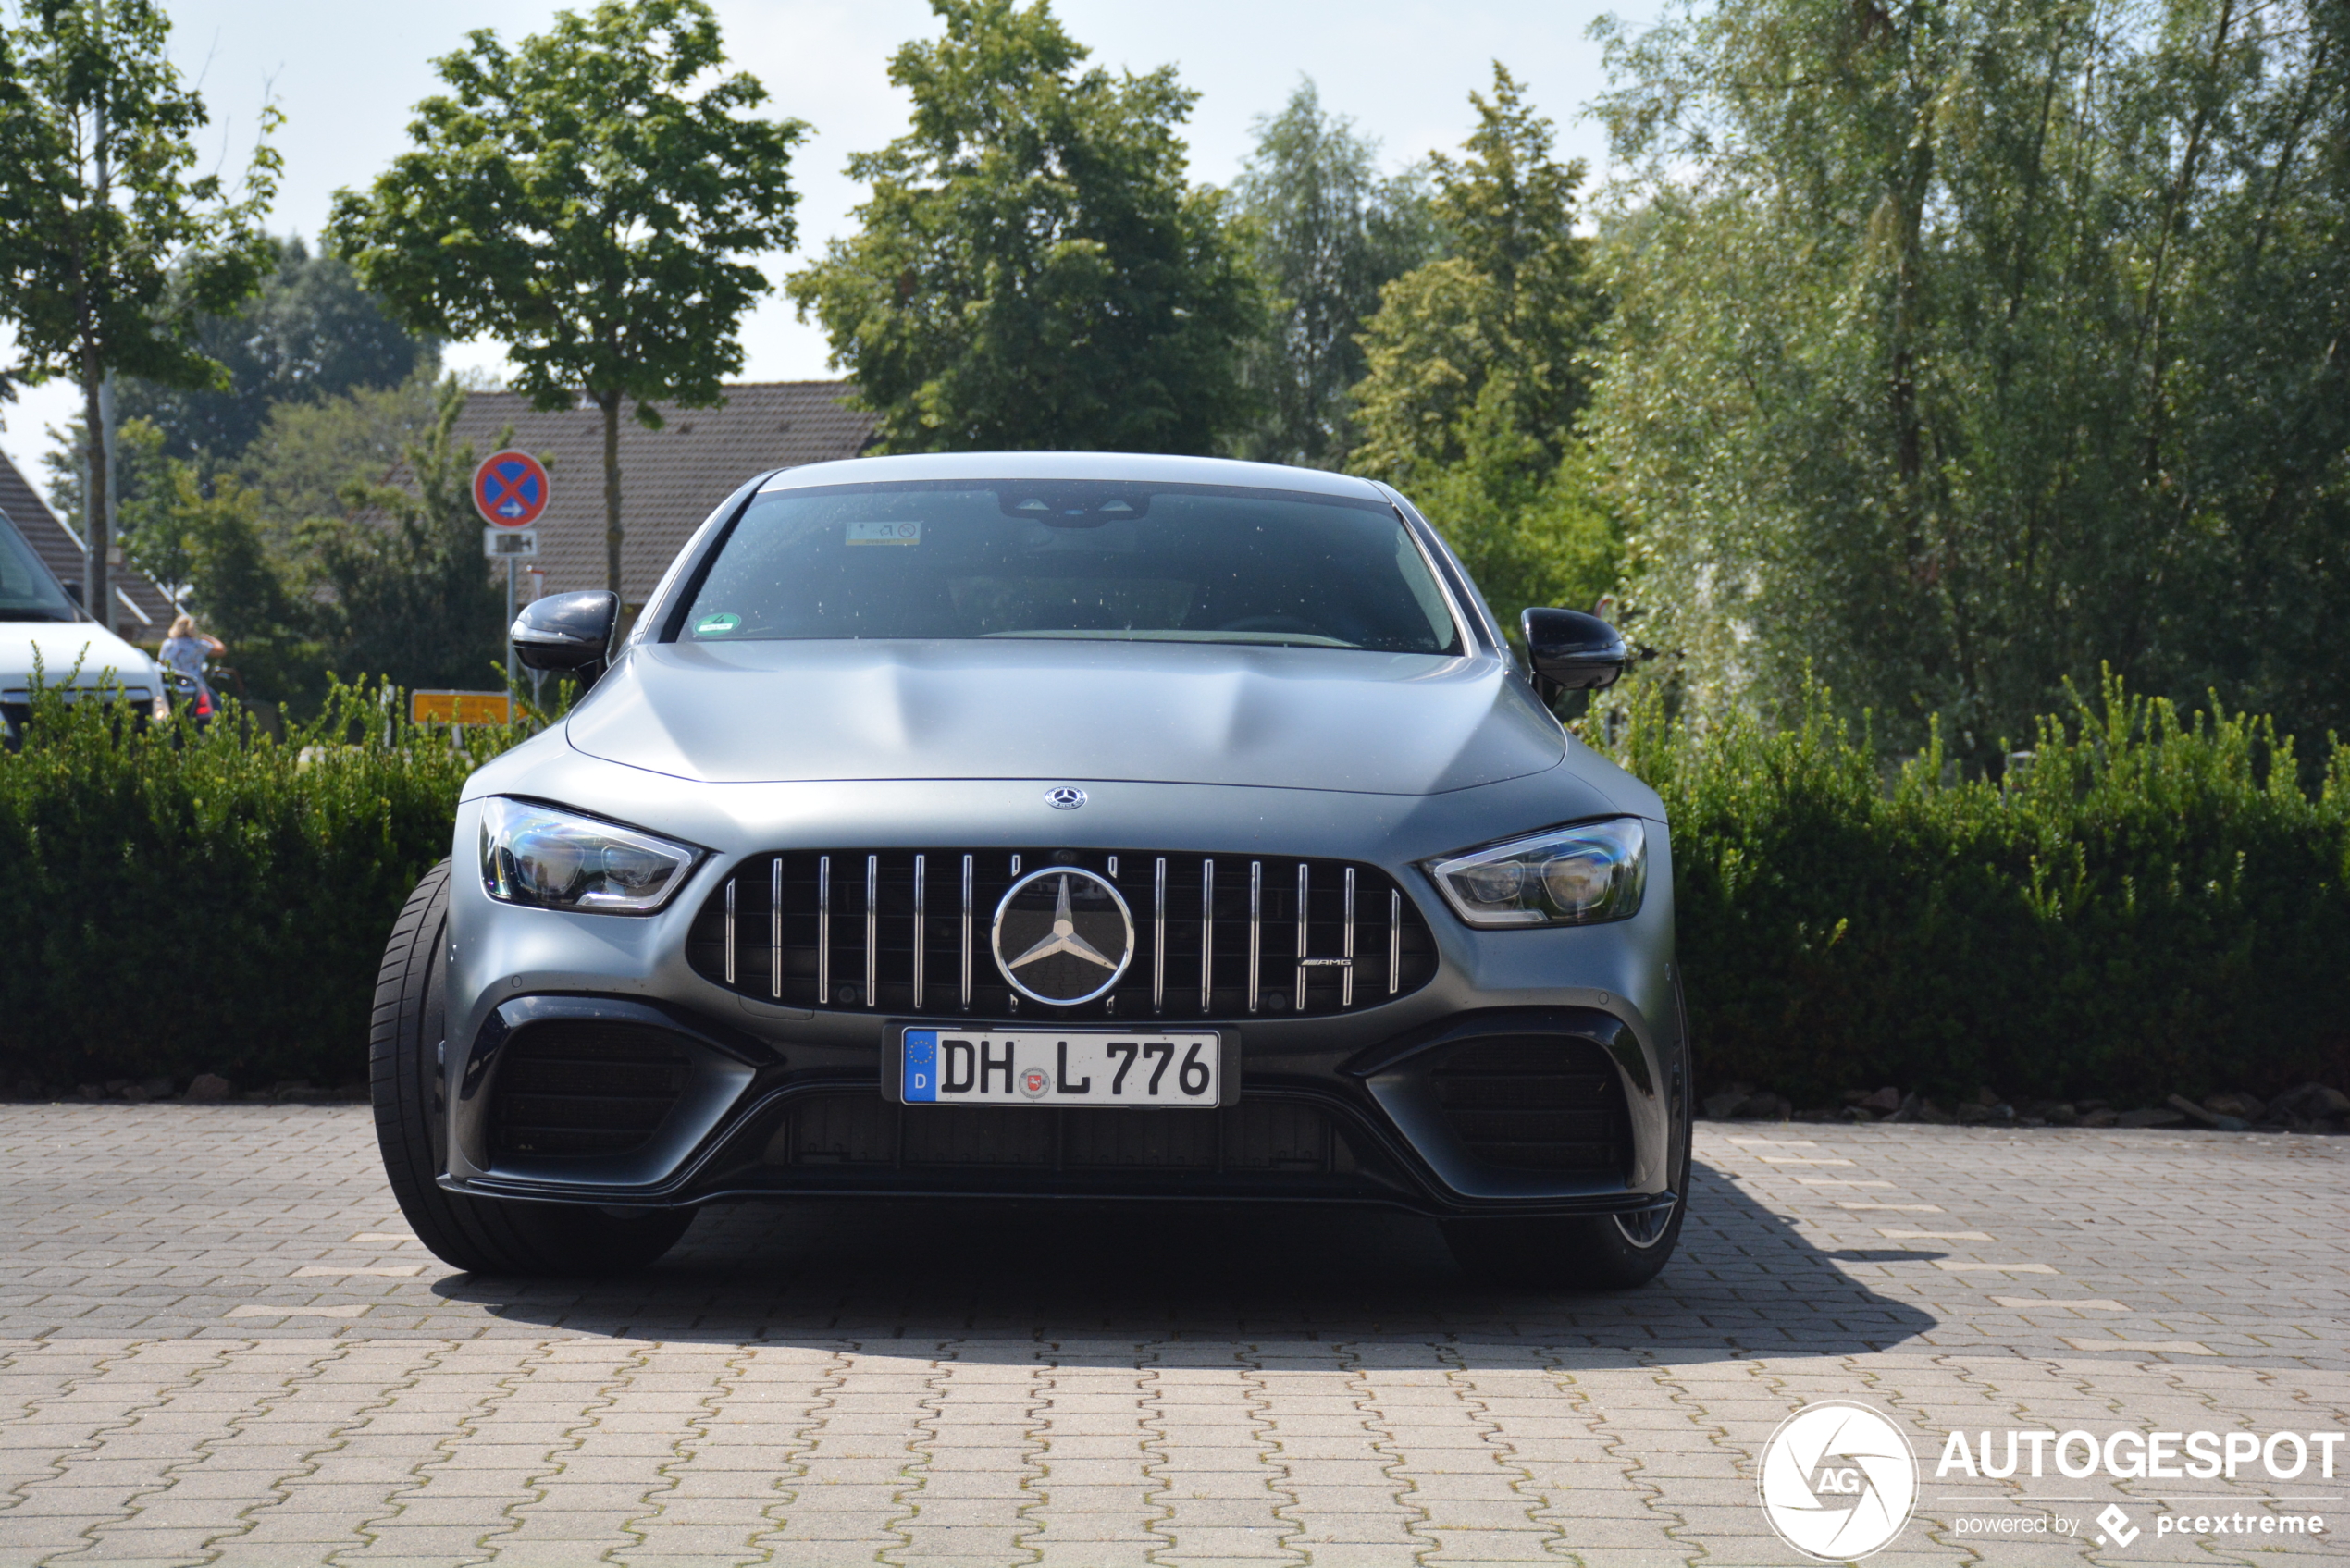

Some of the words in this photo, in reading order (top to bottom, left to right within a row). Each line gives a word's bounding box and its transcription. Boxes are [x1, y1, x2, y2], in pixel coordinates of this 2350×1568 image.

[712, 614, 724, 624] 4
[941, 1040, 1014, 1093] DH
[1057, 1041, 1090, 1094] L
[1107, 1042, 1210, 1096] 776
[914, 1074, 927, 1089] D
